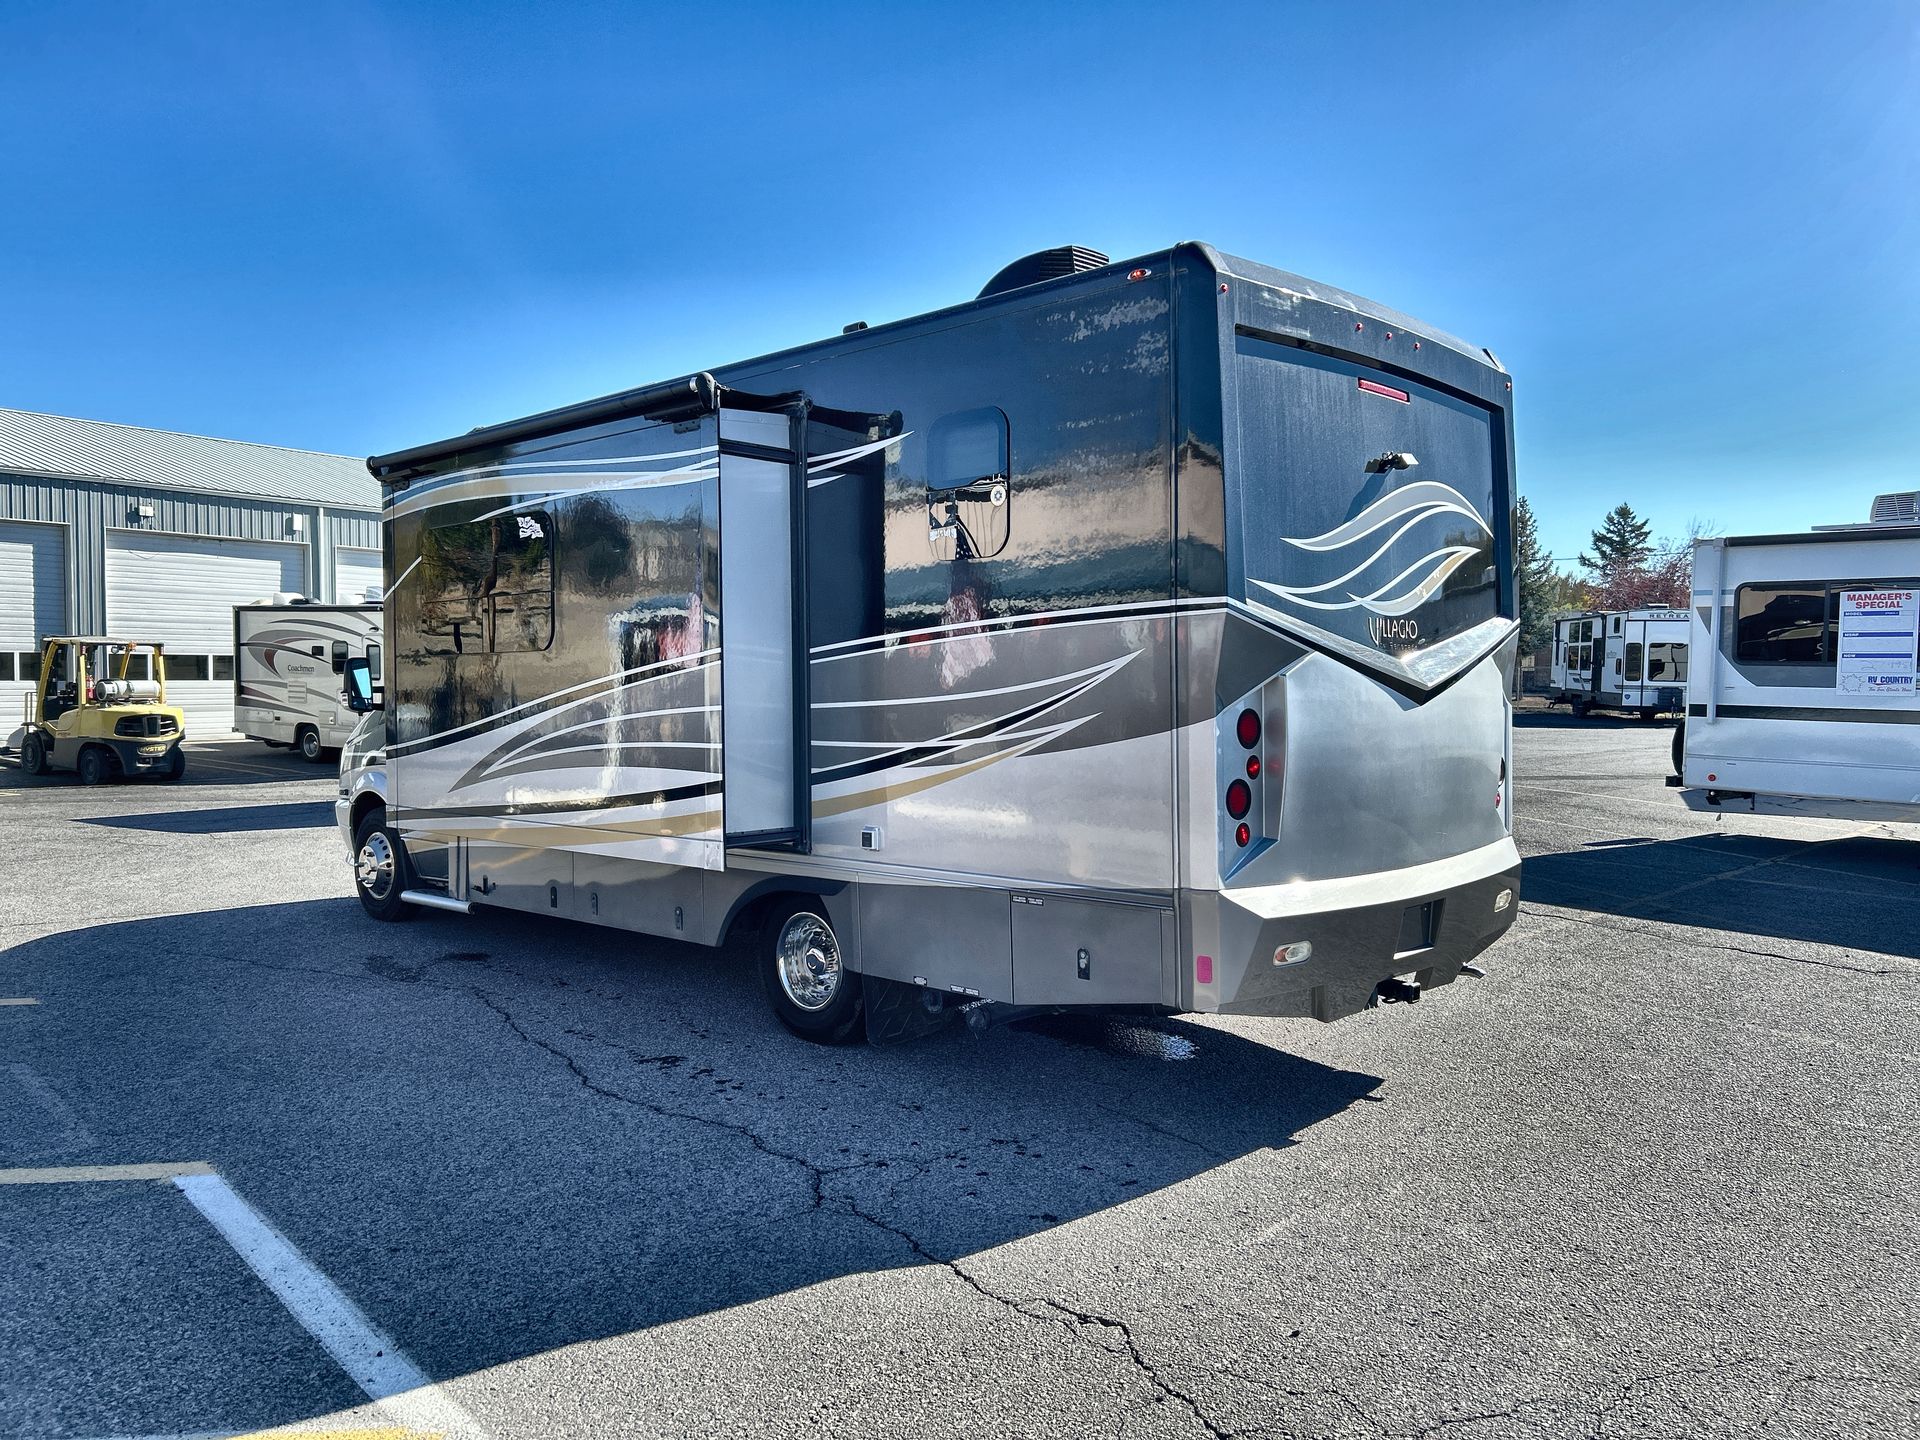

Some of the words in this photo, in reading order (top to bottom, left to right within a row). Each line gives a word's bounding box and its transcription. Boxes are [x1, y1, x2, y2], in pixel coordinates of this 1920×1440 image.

[1847, 592, 1912, 601] MANAGER'S
[1855, 601, 1903, 609] SPECIAL
[1368, 616, 1418, 646] VILLAGIO
[287, 664, 315, 673] Coachmen
[1880, 676, 1914, 684] COUNTRY
